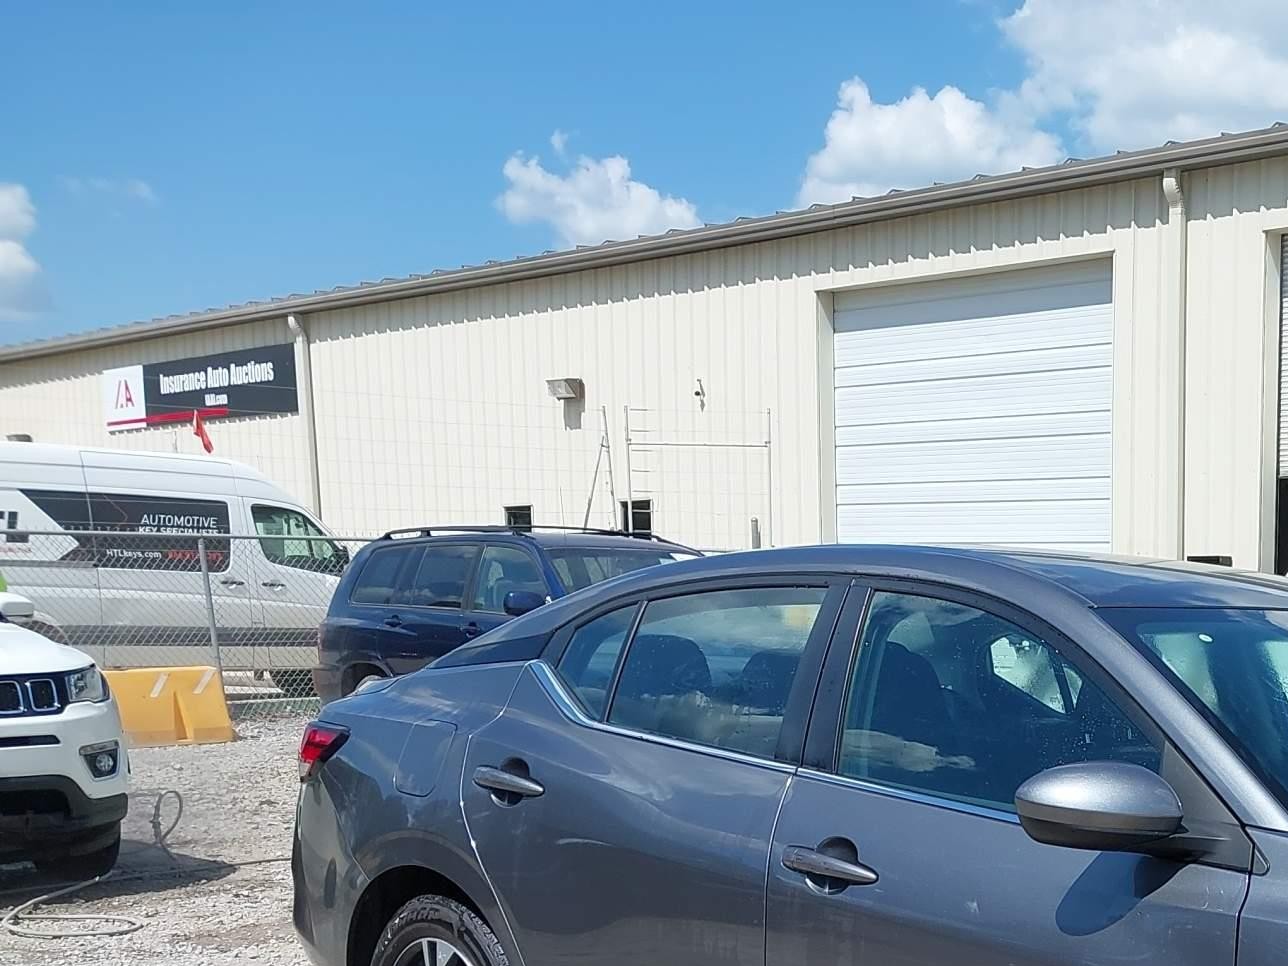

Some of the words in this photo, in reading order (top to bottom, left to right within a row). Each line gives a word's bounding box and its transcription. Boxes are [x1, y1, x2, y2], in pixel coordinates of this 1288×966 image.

[160, 373, 206, 395] Insurance
[207, 367, 229, 389] Auto
[230, 361, 274, 386] Auctions
[141, 514, 218, 528] AUTOMOTIVE
[106, 549, 161, 559] HTLkeys.com
